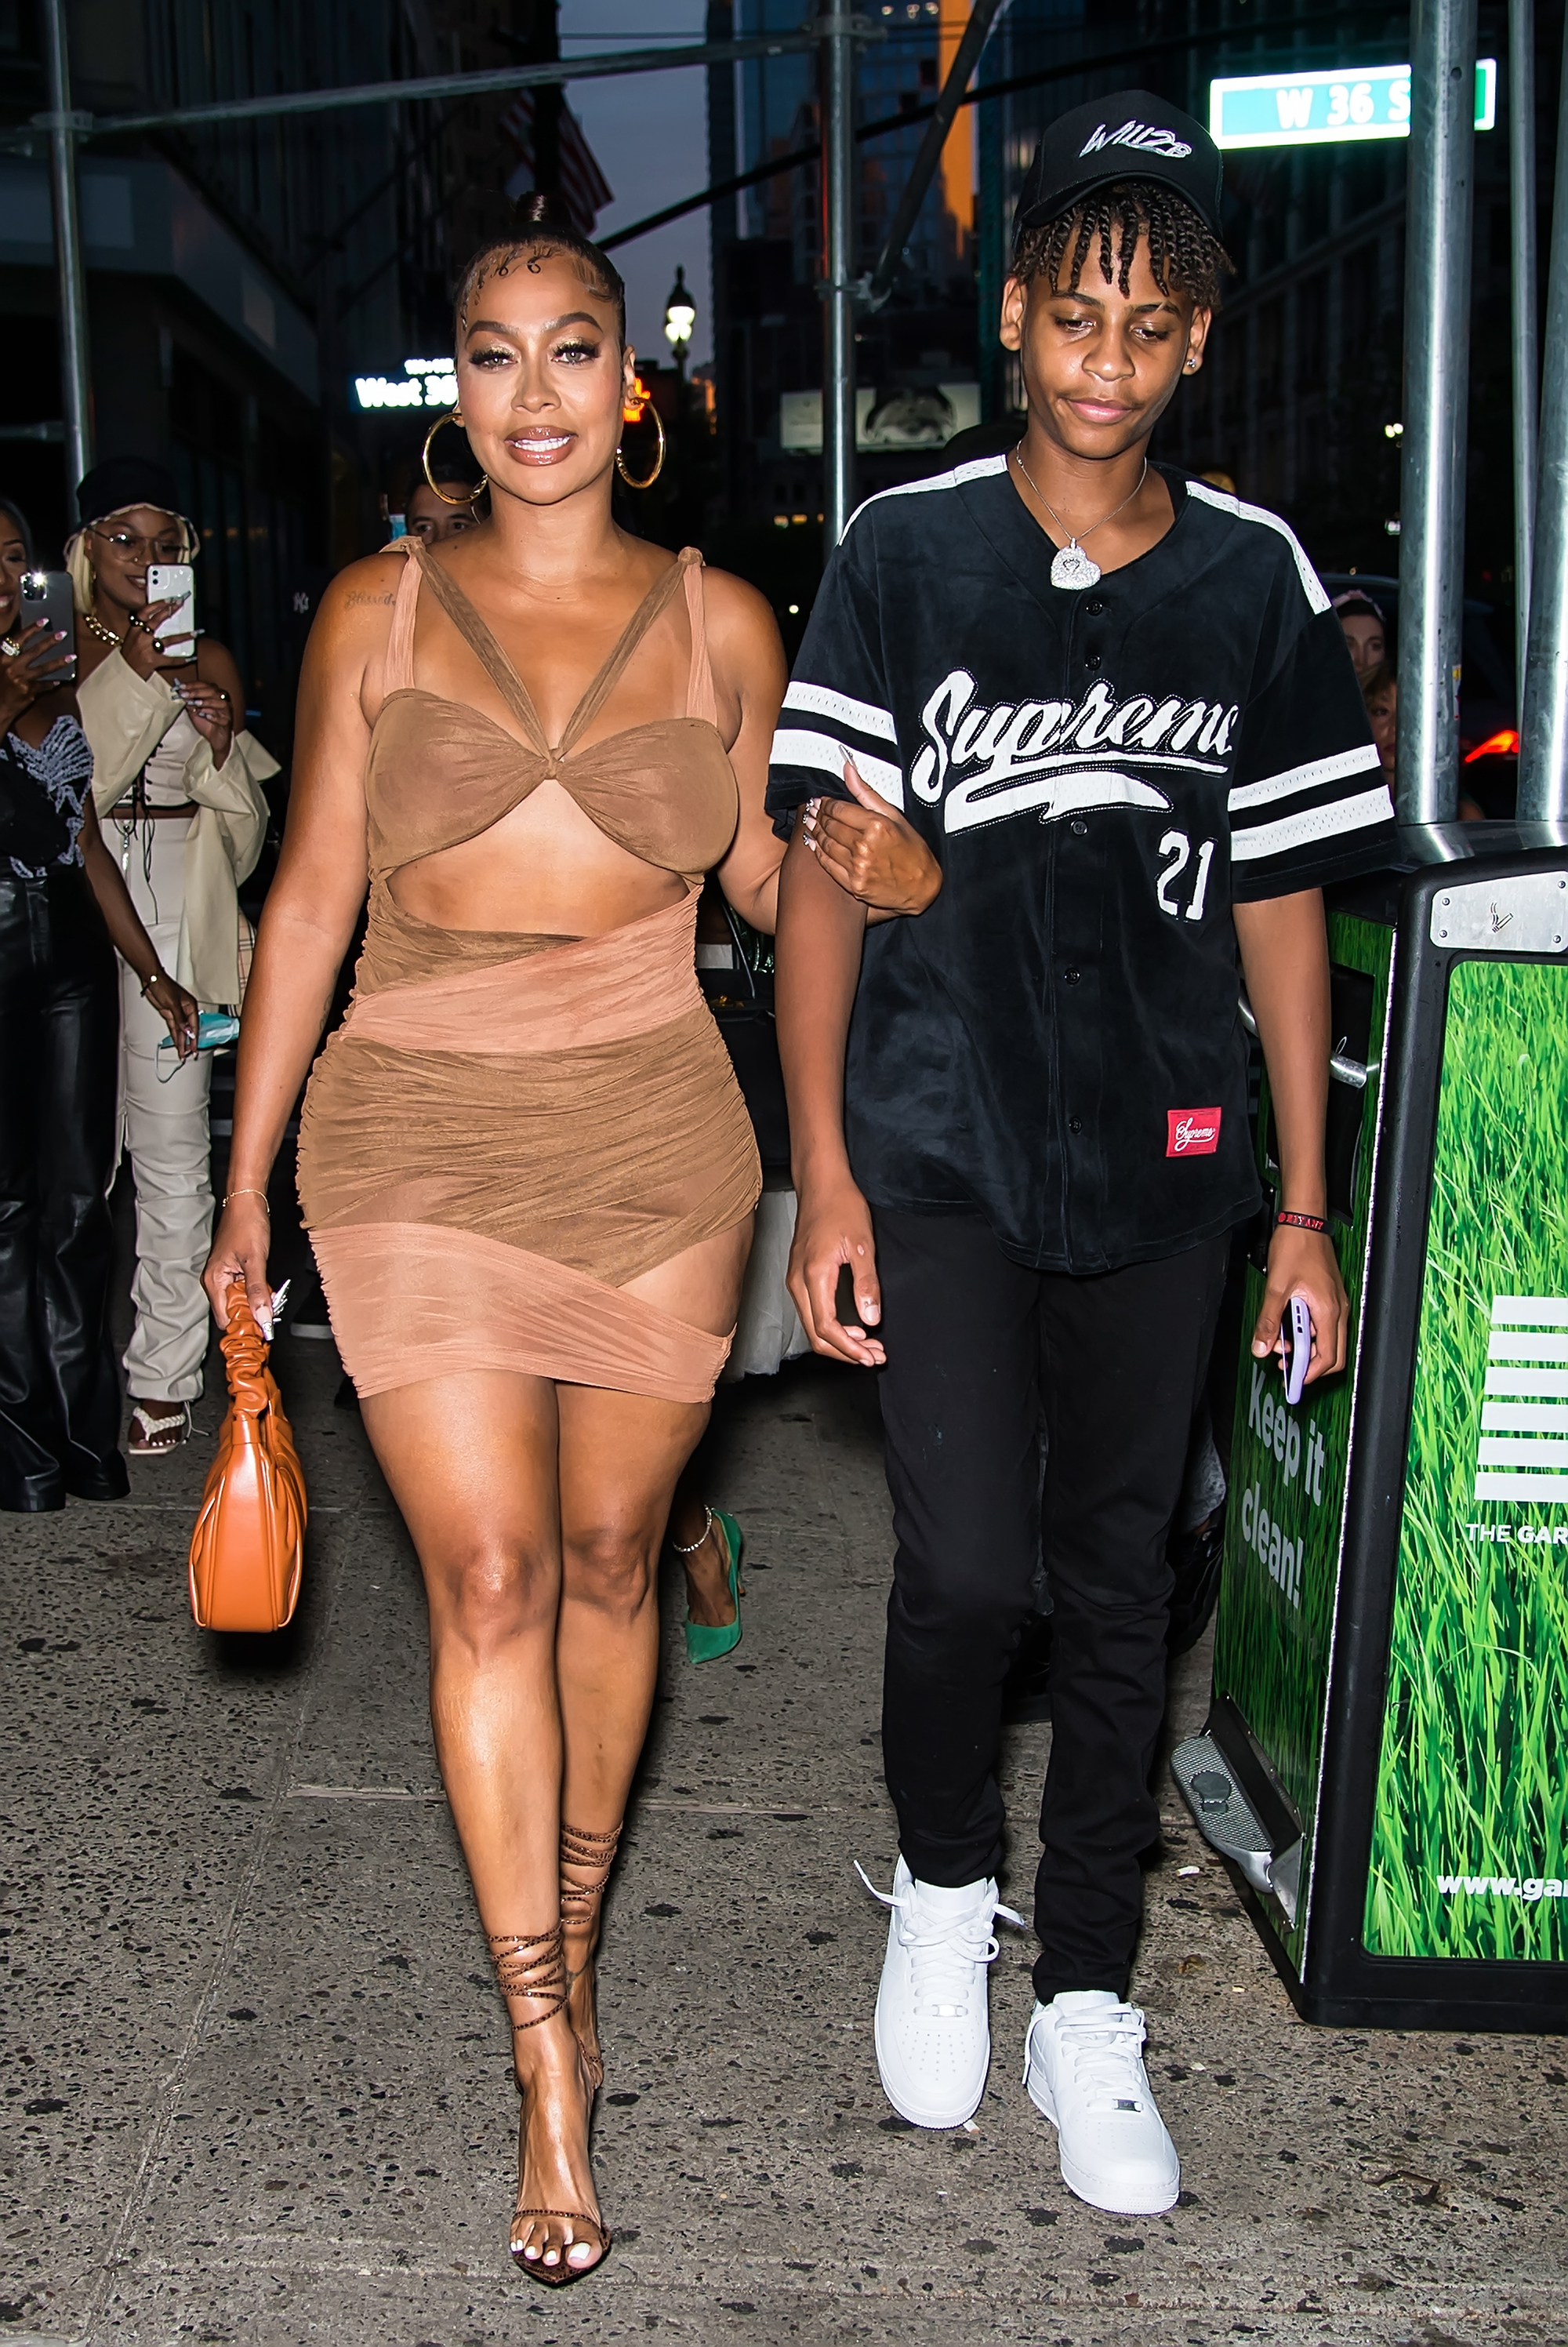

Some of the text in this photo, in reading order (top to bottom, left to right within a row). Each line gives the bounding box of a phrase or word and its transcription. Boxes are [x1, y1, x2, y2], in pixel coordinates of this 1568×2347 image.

[1276, 87, 1313, 129] W
[1327, 82, 1374, 125] 36
[911, 669, 1240, 834] Suprem
[1156, 830, 1214, 920] 21
[1248, 1361, 1324, 1506] Keep it
[1242, 1480, 1304, 1609] clean!
[1465, 1524, 1568, 1544] THE GAR
